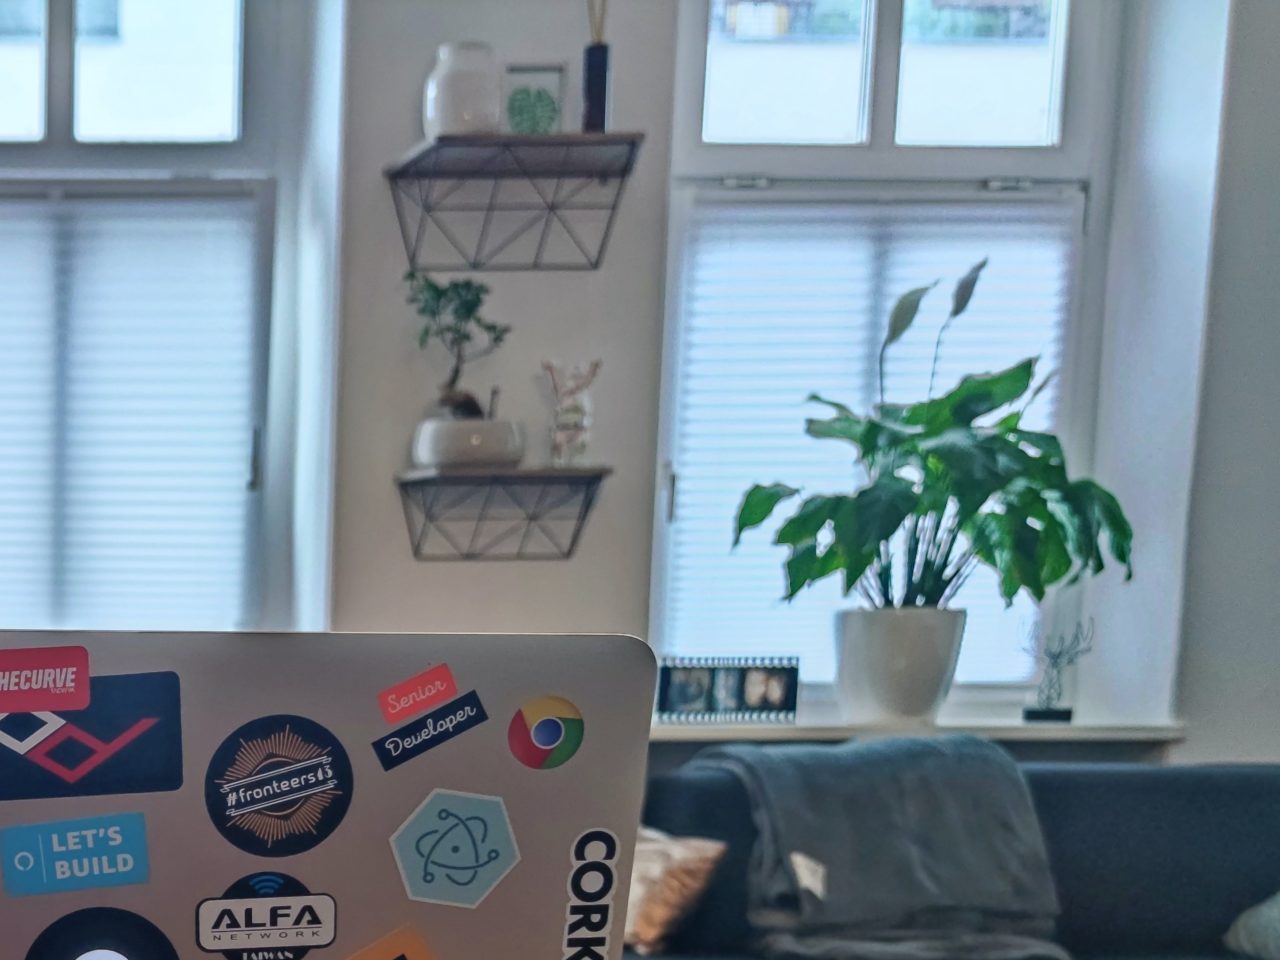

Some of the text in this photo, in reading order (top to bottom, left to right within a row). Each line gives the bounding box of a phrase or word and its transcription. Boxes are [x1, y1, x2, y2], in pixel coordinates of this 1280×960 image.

[388, 680, 447, 714] Senior
[384, 706, 477, 757] Developer
[55, 853, 134, 879] BUILD
[211, 905, 322, 930] ALFA
[213, 930, 320, 941] NETWORK
